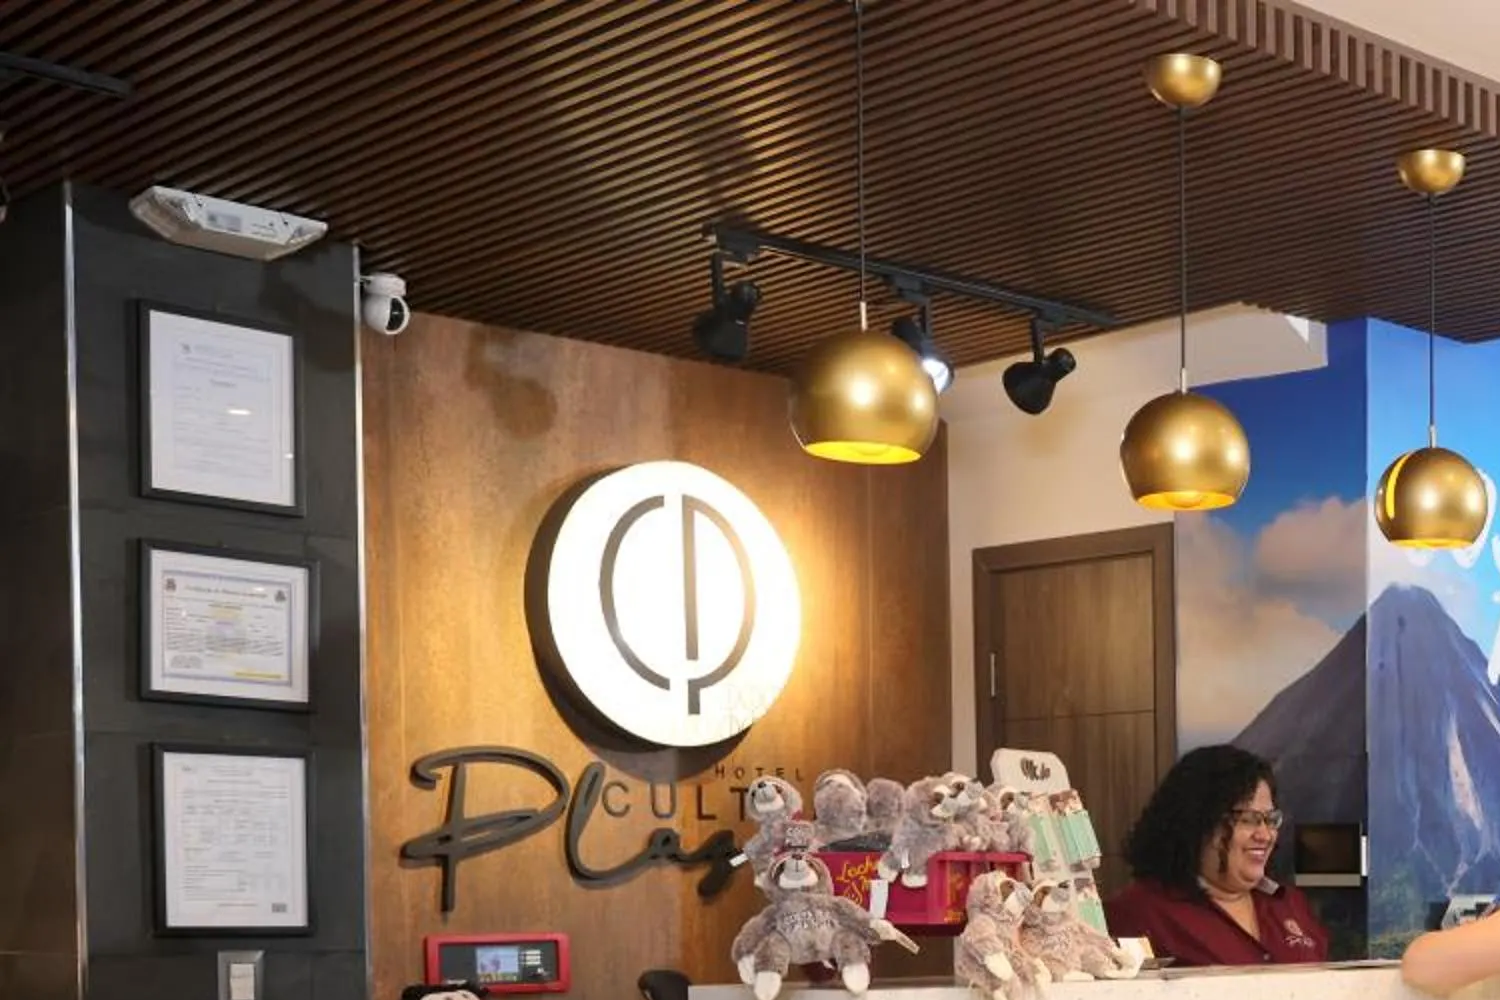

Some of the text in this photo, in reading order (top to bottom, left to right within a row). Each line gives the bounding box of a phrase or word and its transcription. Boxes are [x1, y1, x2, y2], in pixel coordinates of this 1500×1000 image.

[714, 764, 804, 782] HOTEL
[602, 780, 750, 822] CULT
[400, 745, 748, 921] Plaz
